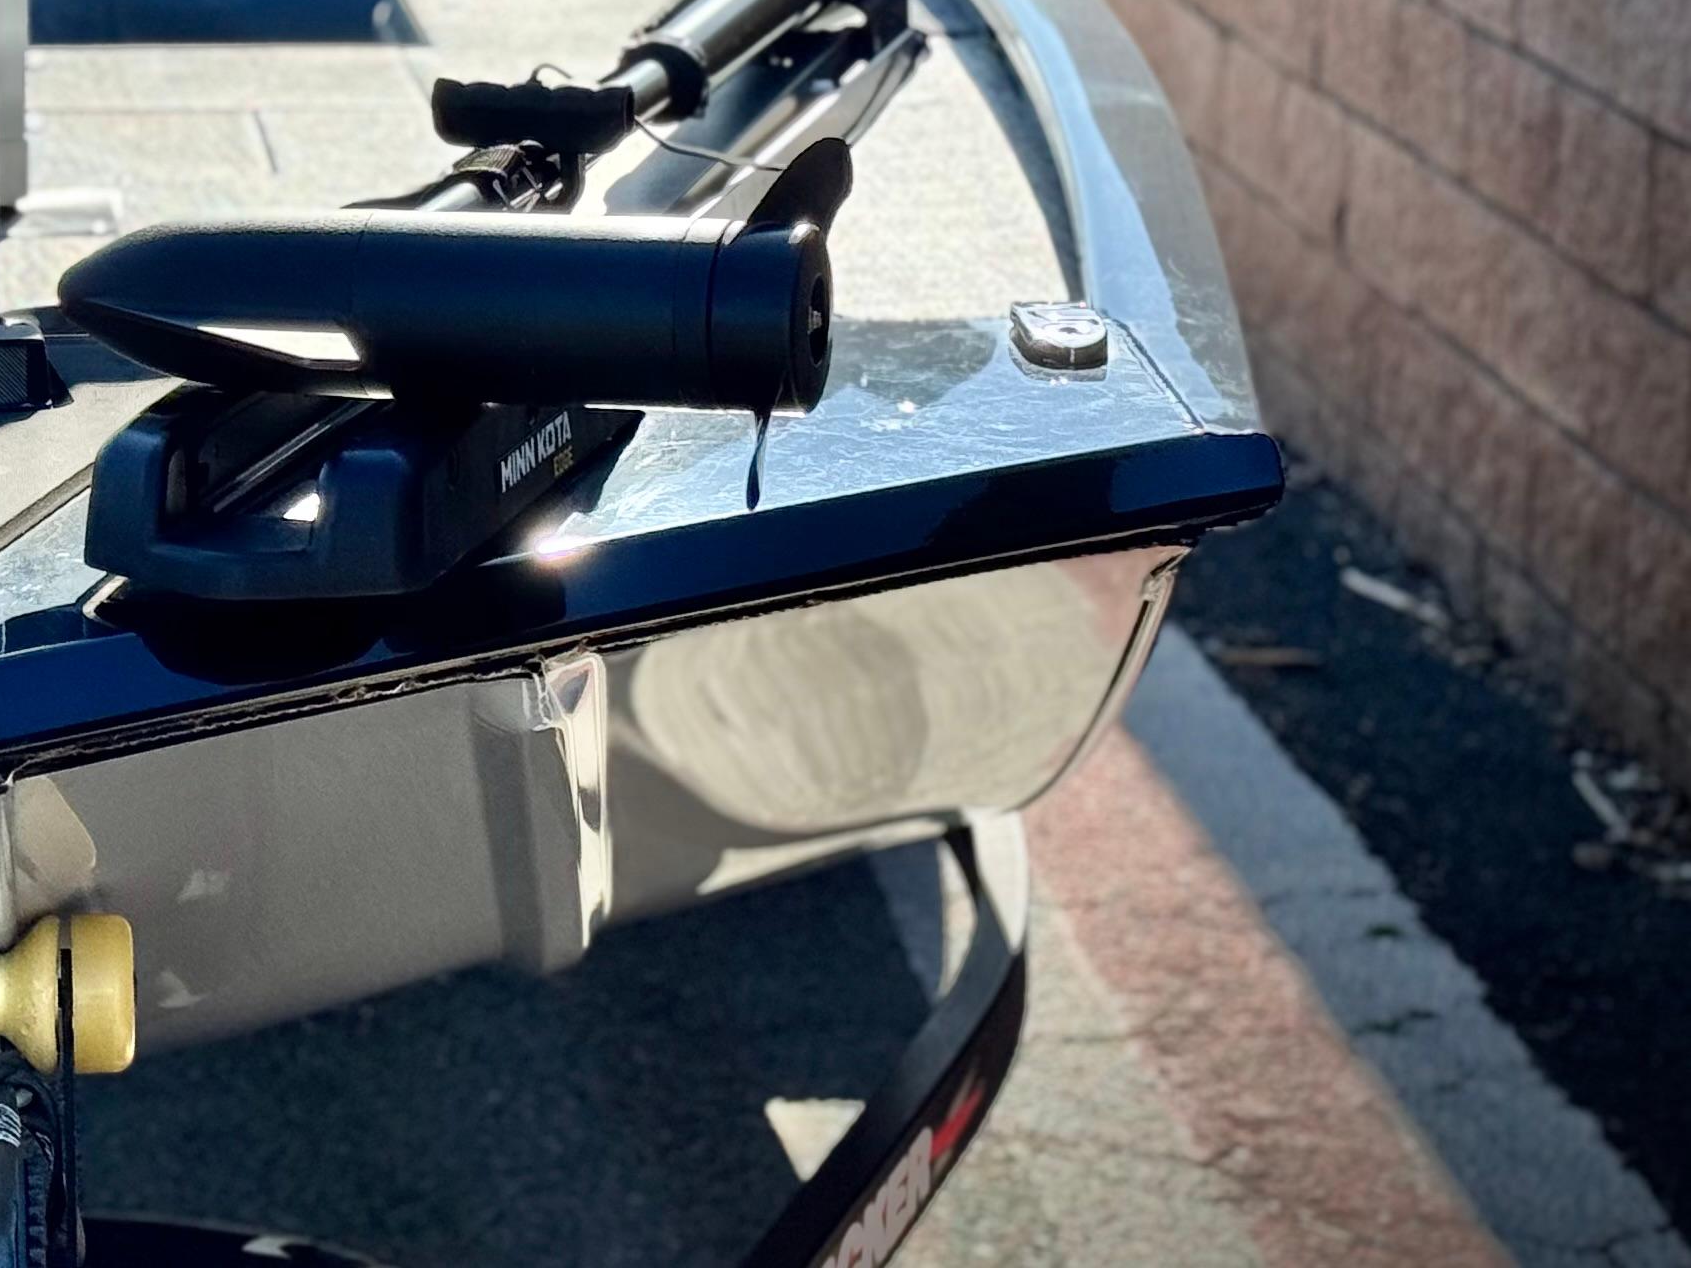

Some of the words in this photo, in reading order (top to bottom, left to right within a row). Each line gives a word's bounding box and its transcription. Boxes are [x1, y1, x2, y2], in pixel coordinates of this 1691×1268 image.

[500, 436, 536, 494] MINN
[536, 411, 572, 464] KOTA
[822, 1126, 935, 1268] CKER
